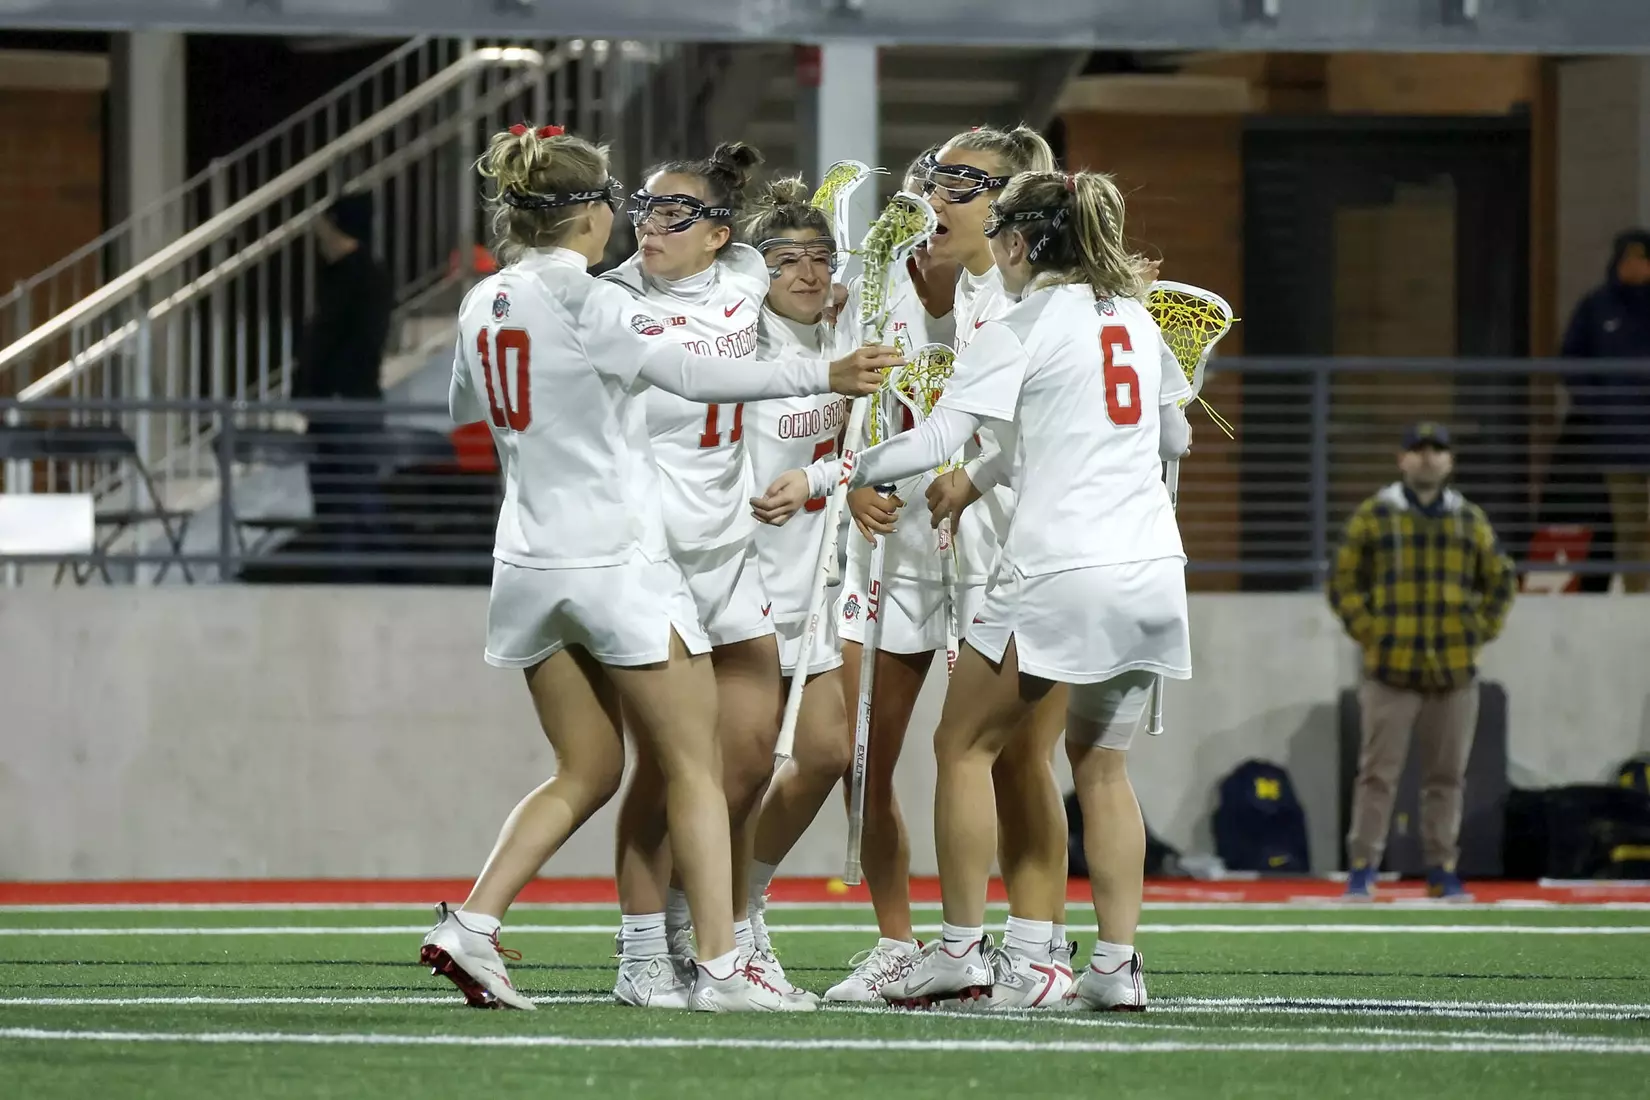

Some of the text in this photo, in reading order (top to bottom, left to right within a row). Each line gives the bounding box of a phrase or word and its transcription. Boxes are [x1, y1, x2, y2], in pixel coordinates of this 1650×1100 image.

[568, 190, 604, 201] STX
[710, 207, 731, 216] STX
[1014, 210, 1045, 220] STX
[1029, 234, 1050, 261] STX
[476, 326, 533, 433] 10
[1099, 323, 1143, 428] 6
[778, 396, 847, 439] OHIO STA
[866, 579, 881, 624] STX
[856, 743, 865, 776] EXULT
